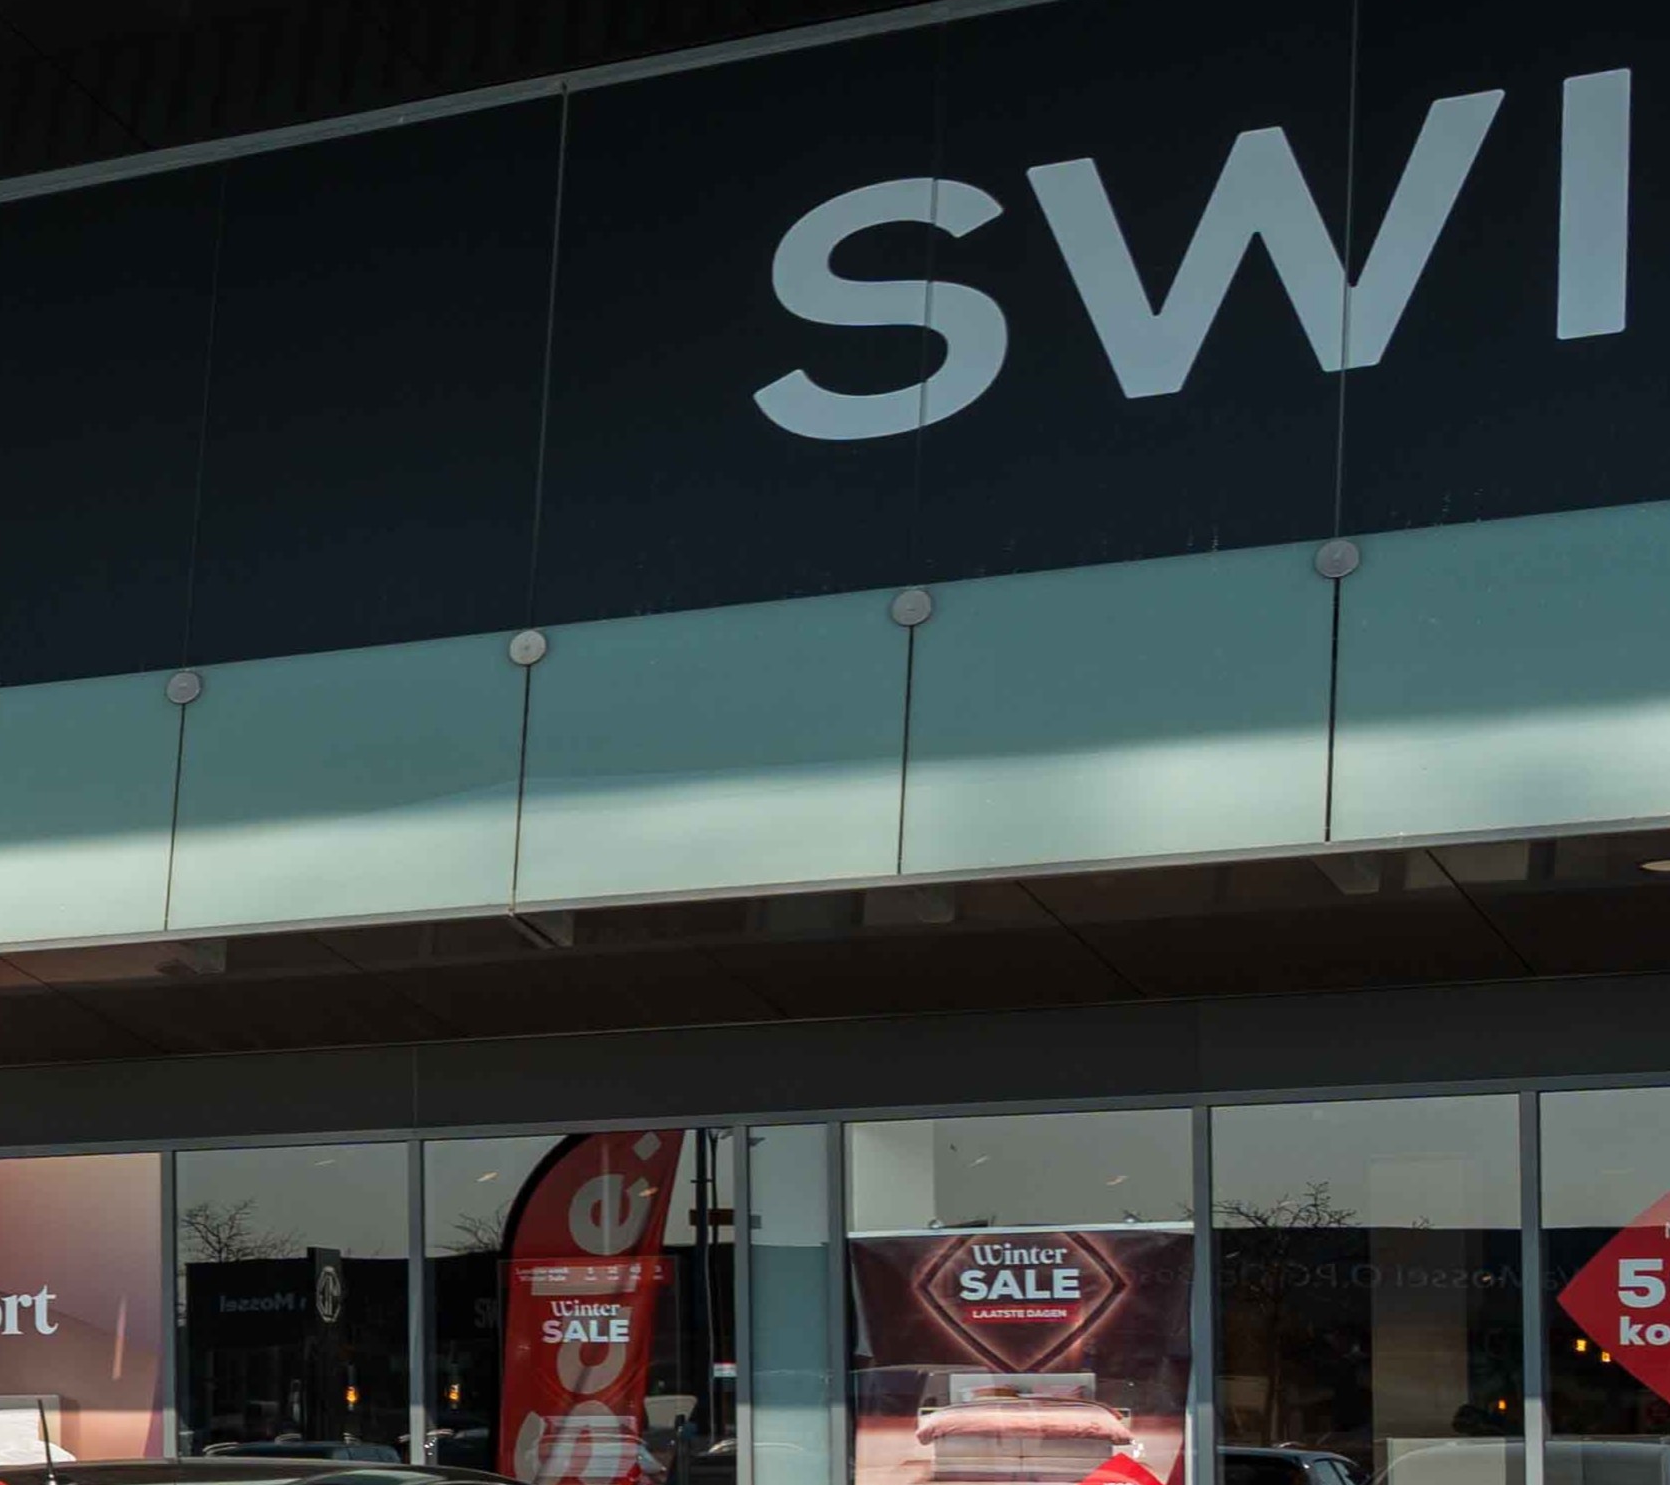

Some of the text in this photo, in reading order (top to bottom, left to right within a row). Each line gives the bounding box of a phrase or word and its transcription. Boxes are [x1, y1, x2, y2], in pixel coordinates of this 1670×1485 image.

[972, 1242, 1067, 1266] Winter
[959, 1268, 1082, 1301] SALE
[550, 1299, 621, 1317] Winter
[972, 1308, 1067, 1319] LAATSTE DAGEN
[542, 1319, 630, 1344] SALE
